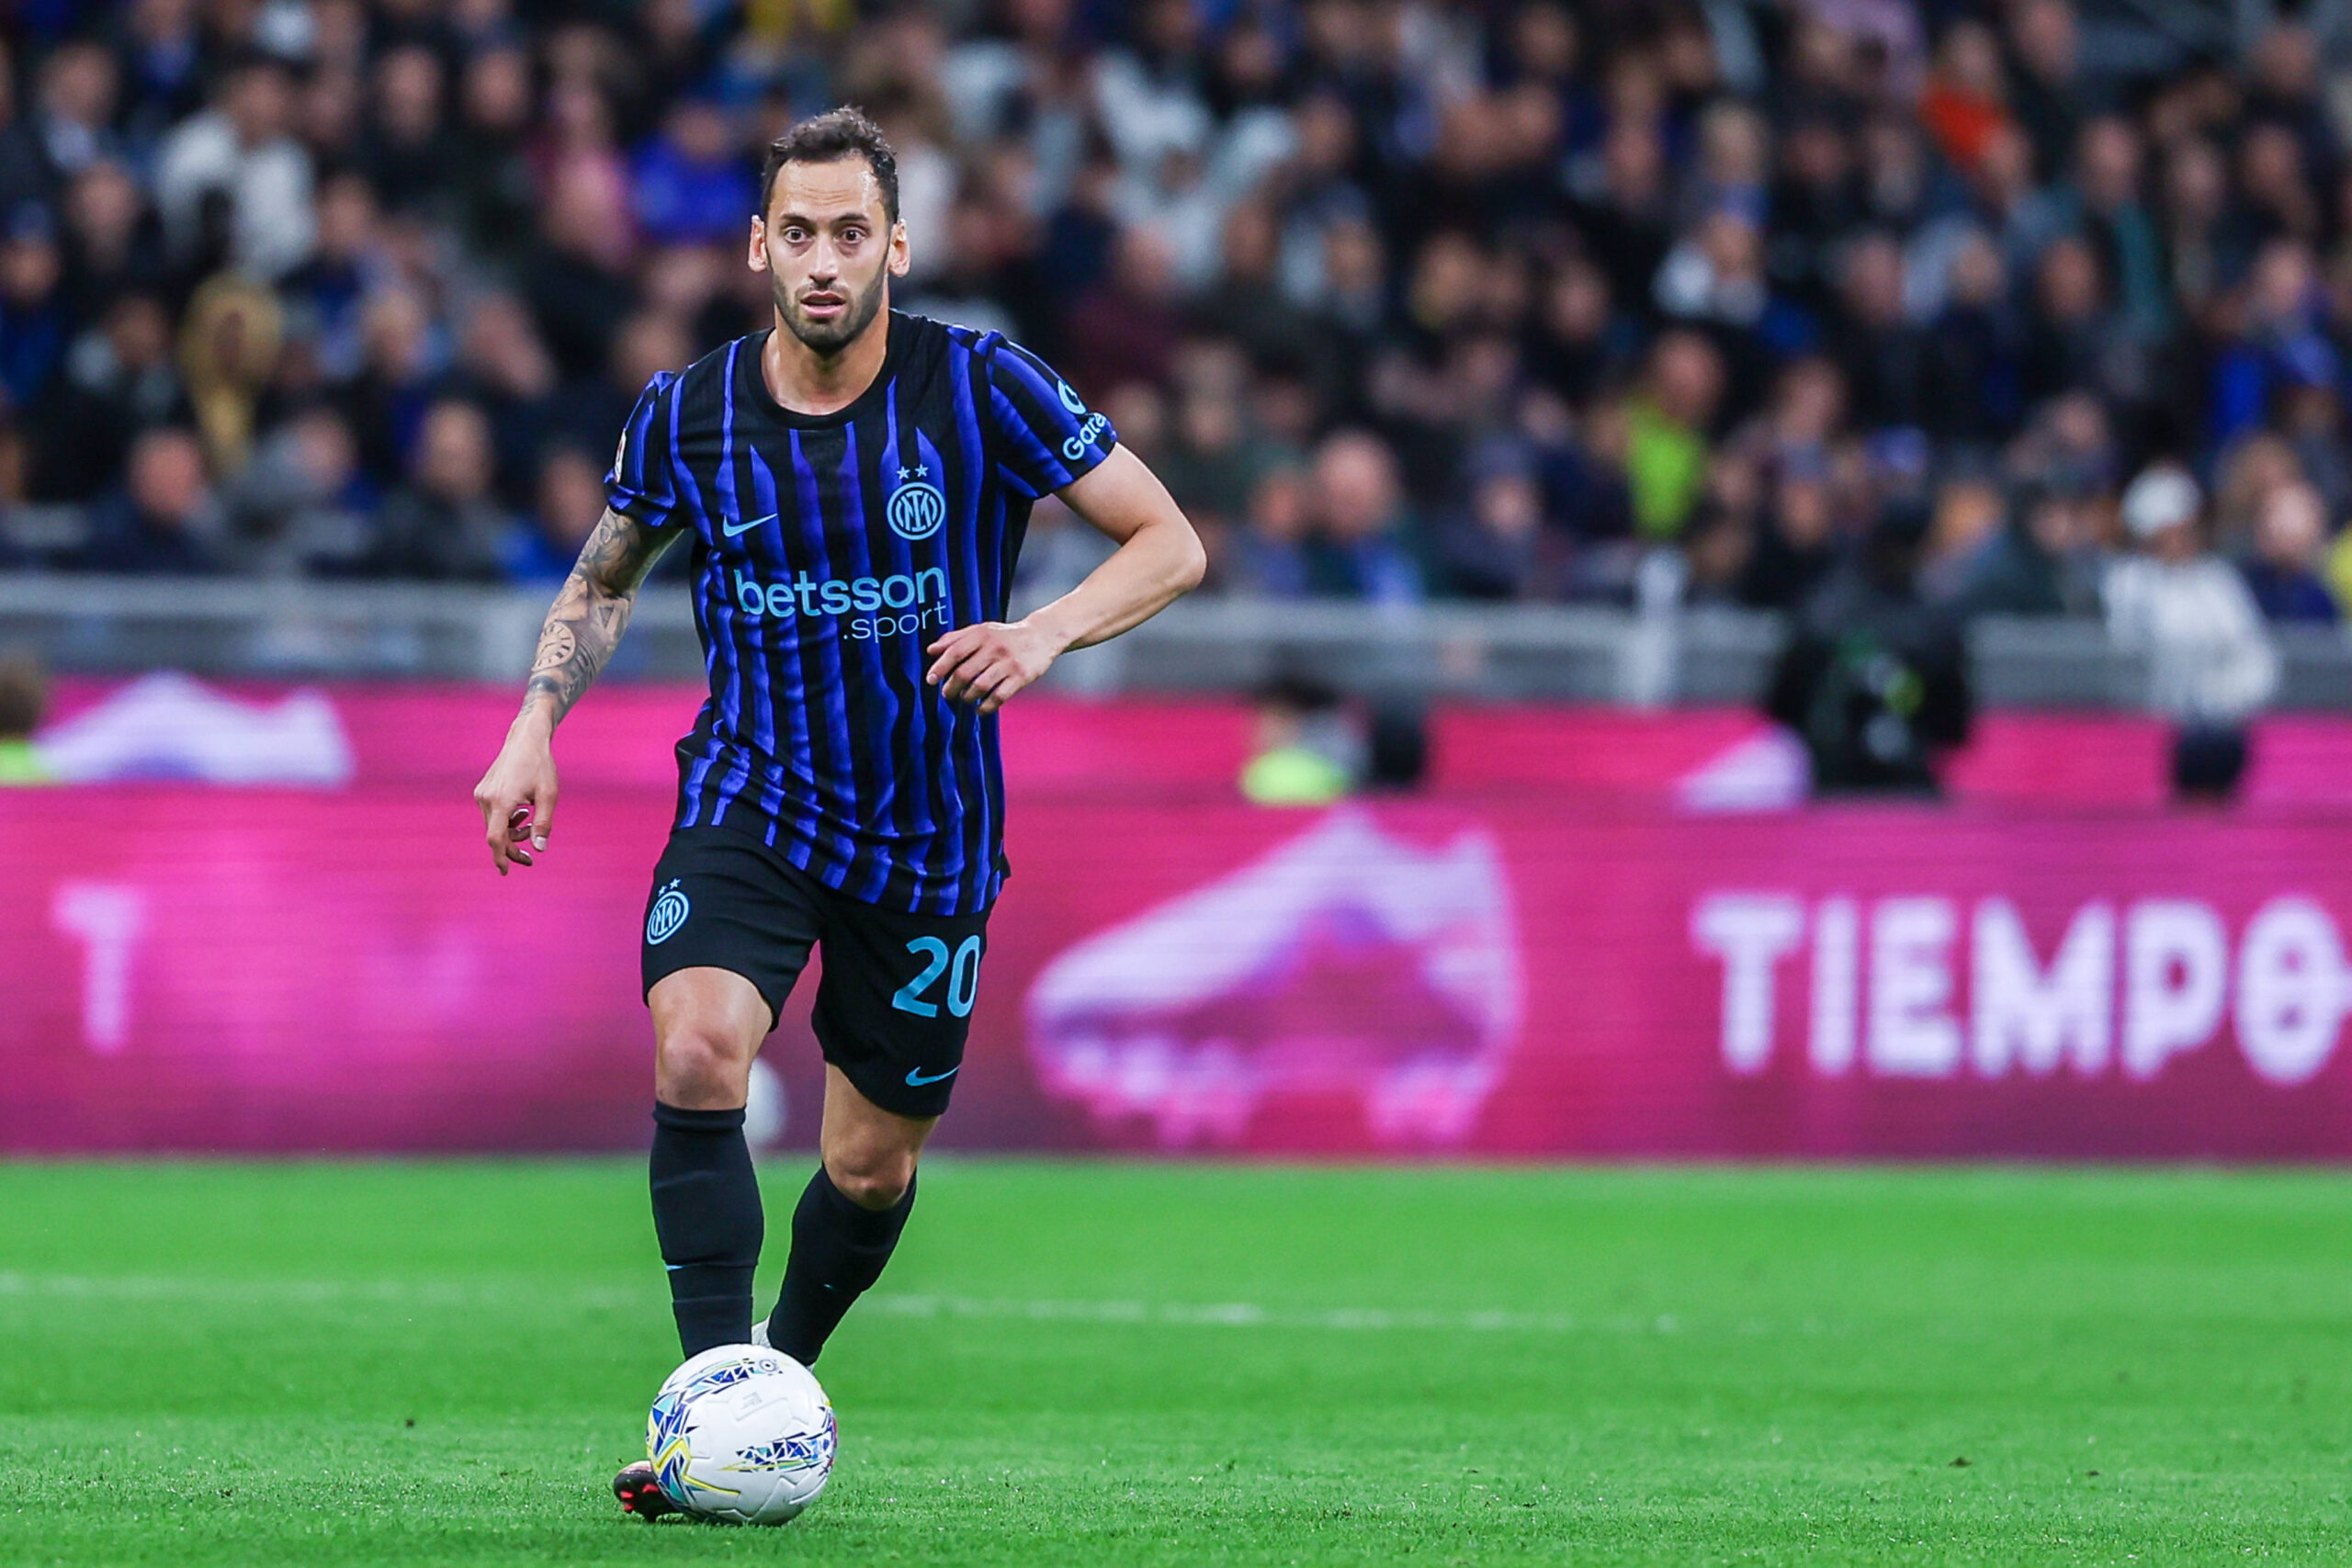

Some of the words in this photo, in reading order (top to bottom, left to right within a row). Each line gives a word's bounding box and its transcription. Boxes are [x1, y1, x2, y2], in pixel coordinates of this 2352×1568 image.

[734, 567, 946, 617] betsson
[843, 602, 949, 643] .sport
[892, 935, 980, 1018] 20
